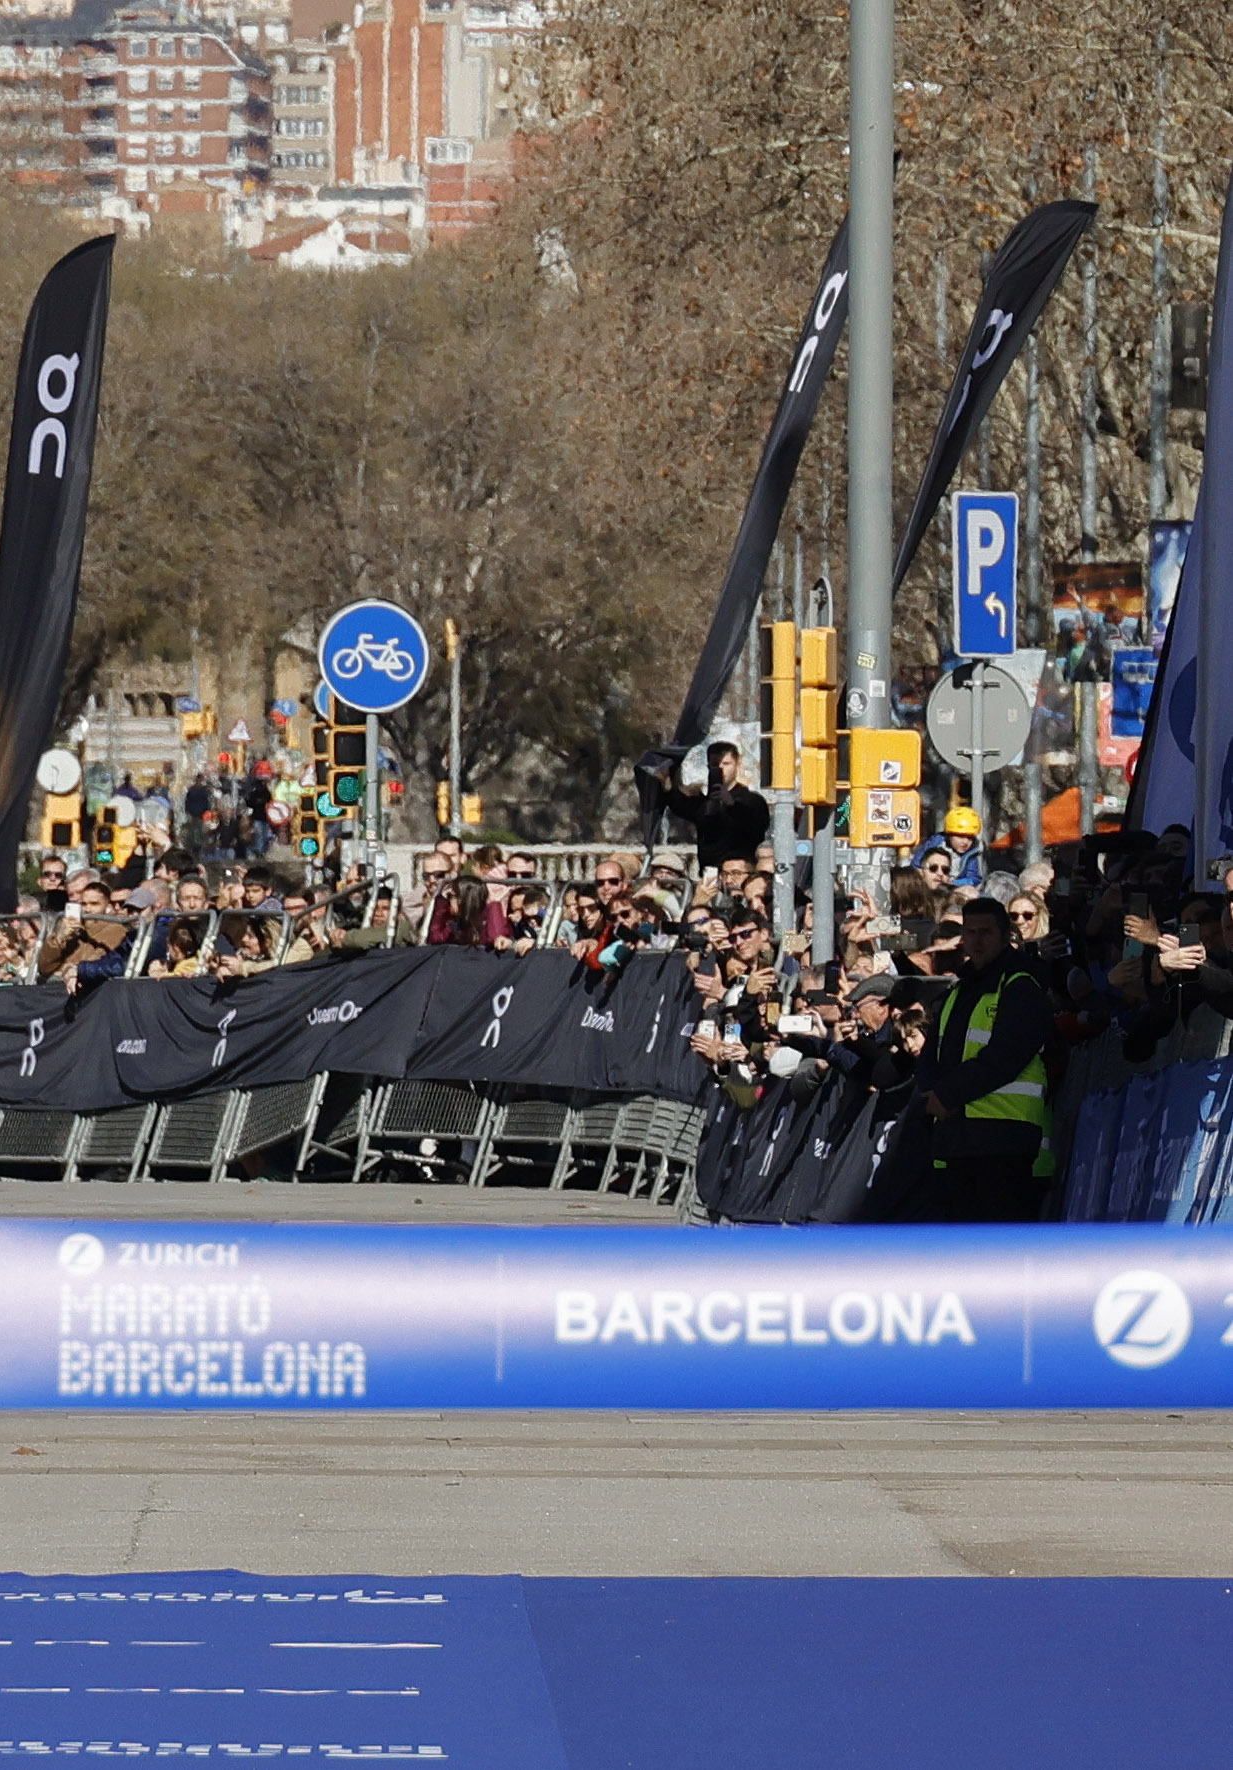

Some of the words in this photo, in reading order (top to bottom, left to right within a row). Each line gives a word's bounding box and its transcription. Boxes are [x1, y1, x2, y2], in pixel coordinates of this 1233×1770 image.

[967, 509, 1005, 595] P
[119, 1243, 239, 1267] ZURICH
[59, 1274, 271, 1336] MARATÓ
[554, 1291, 976, 1346] BARCELONA
[59, 1340, 366, 1397] BARCELONA
